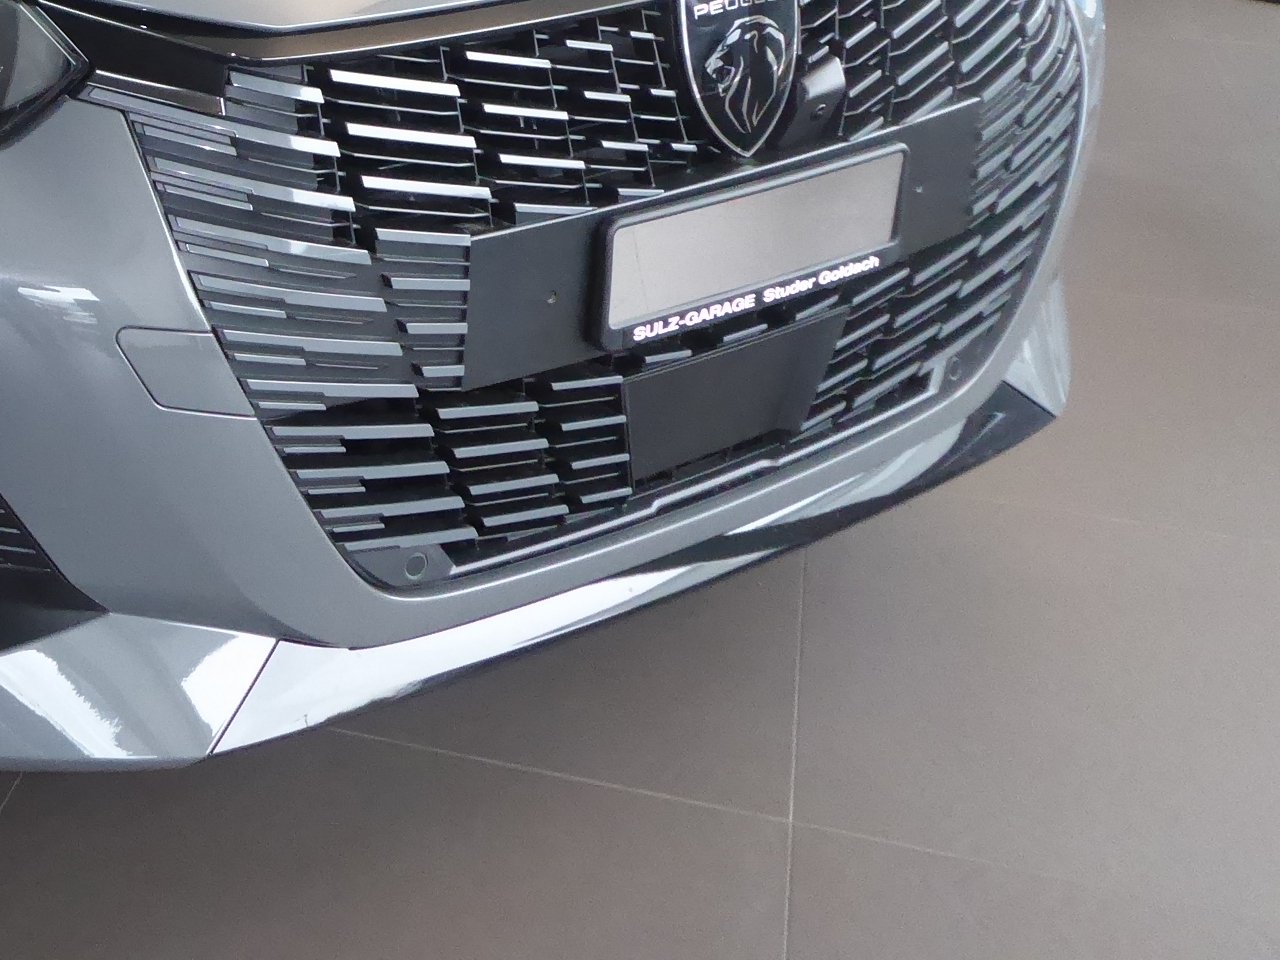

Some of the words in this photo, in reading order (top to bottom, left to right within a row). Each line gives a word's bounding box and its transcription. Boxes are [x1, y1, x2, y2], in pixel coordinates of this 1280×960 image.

[632, 293, 756, 341] SULZ-GARAGE
[762, 275, 817, 303] Studer
[818, 255, 880, 285] Goldach
